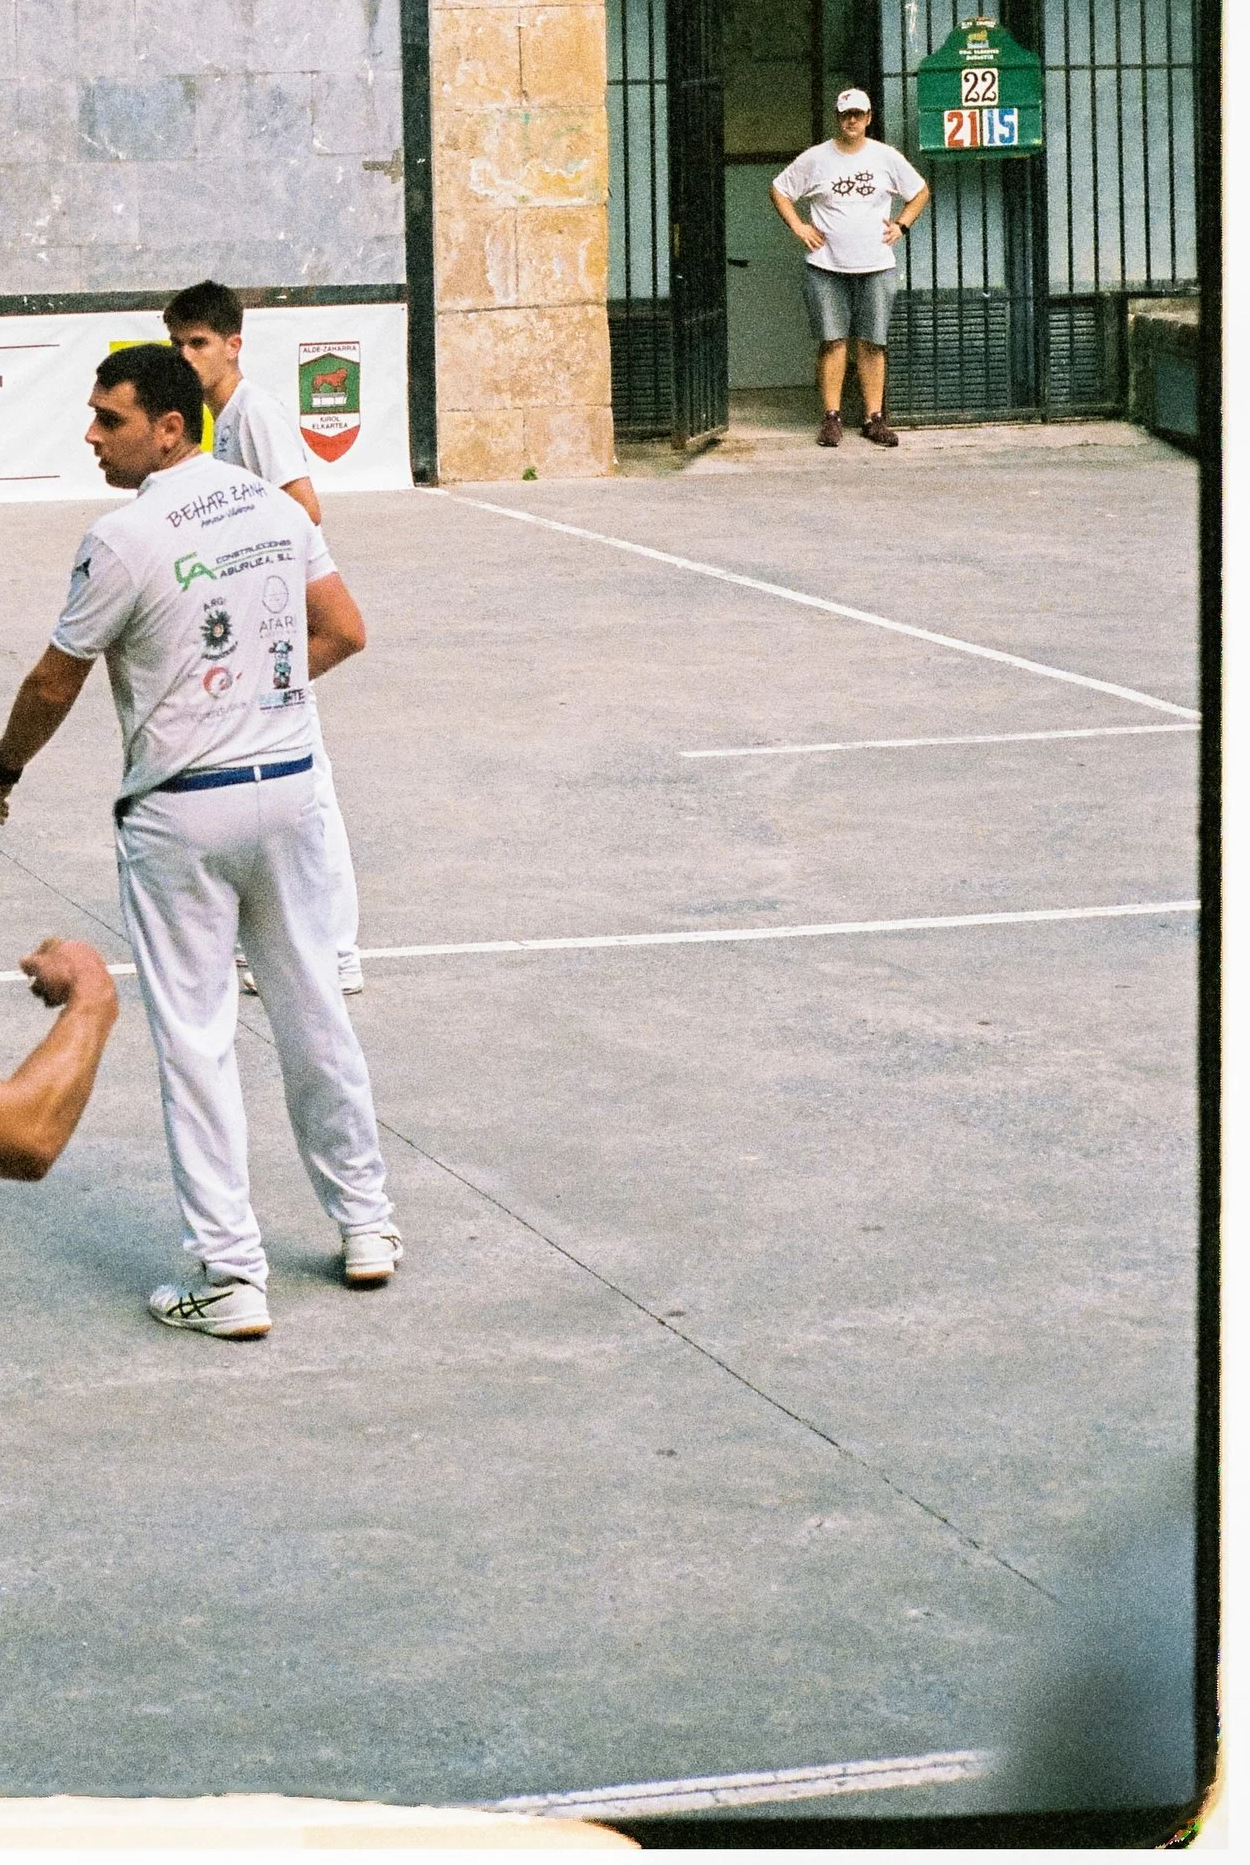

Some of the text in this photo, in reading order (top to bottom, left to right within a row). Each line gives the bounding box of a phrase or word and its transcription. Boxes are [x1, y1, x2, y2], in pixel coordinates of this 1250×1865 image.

[963, 70, 997, 103] 22
[947, 108, 1015, 147] 21 15
[303, 345, 357, 354] ALDE-ZAHARRA
[166, 482, 267, 528] BEHAR ZANA
